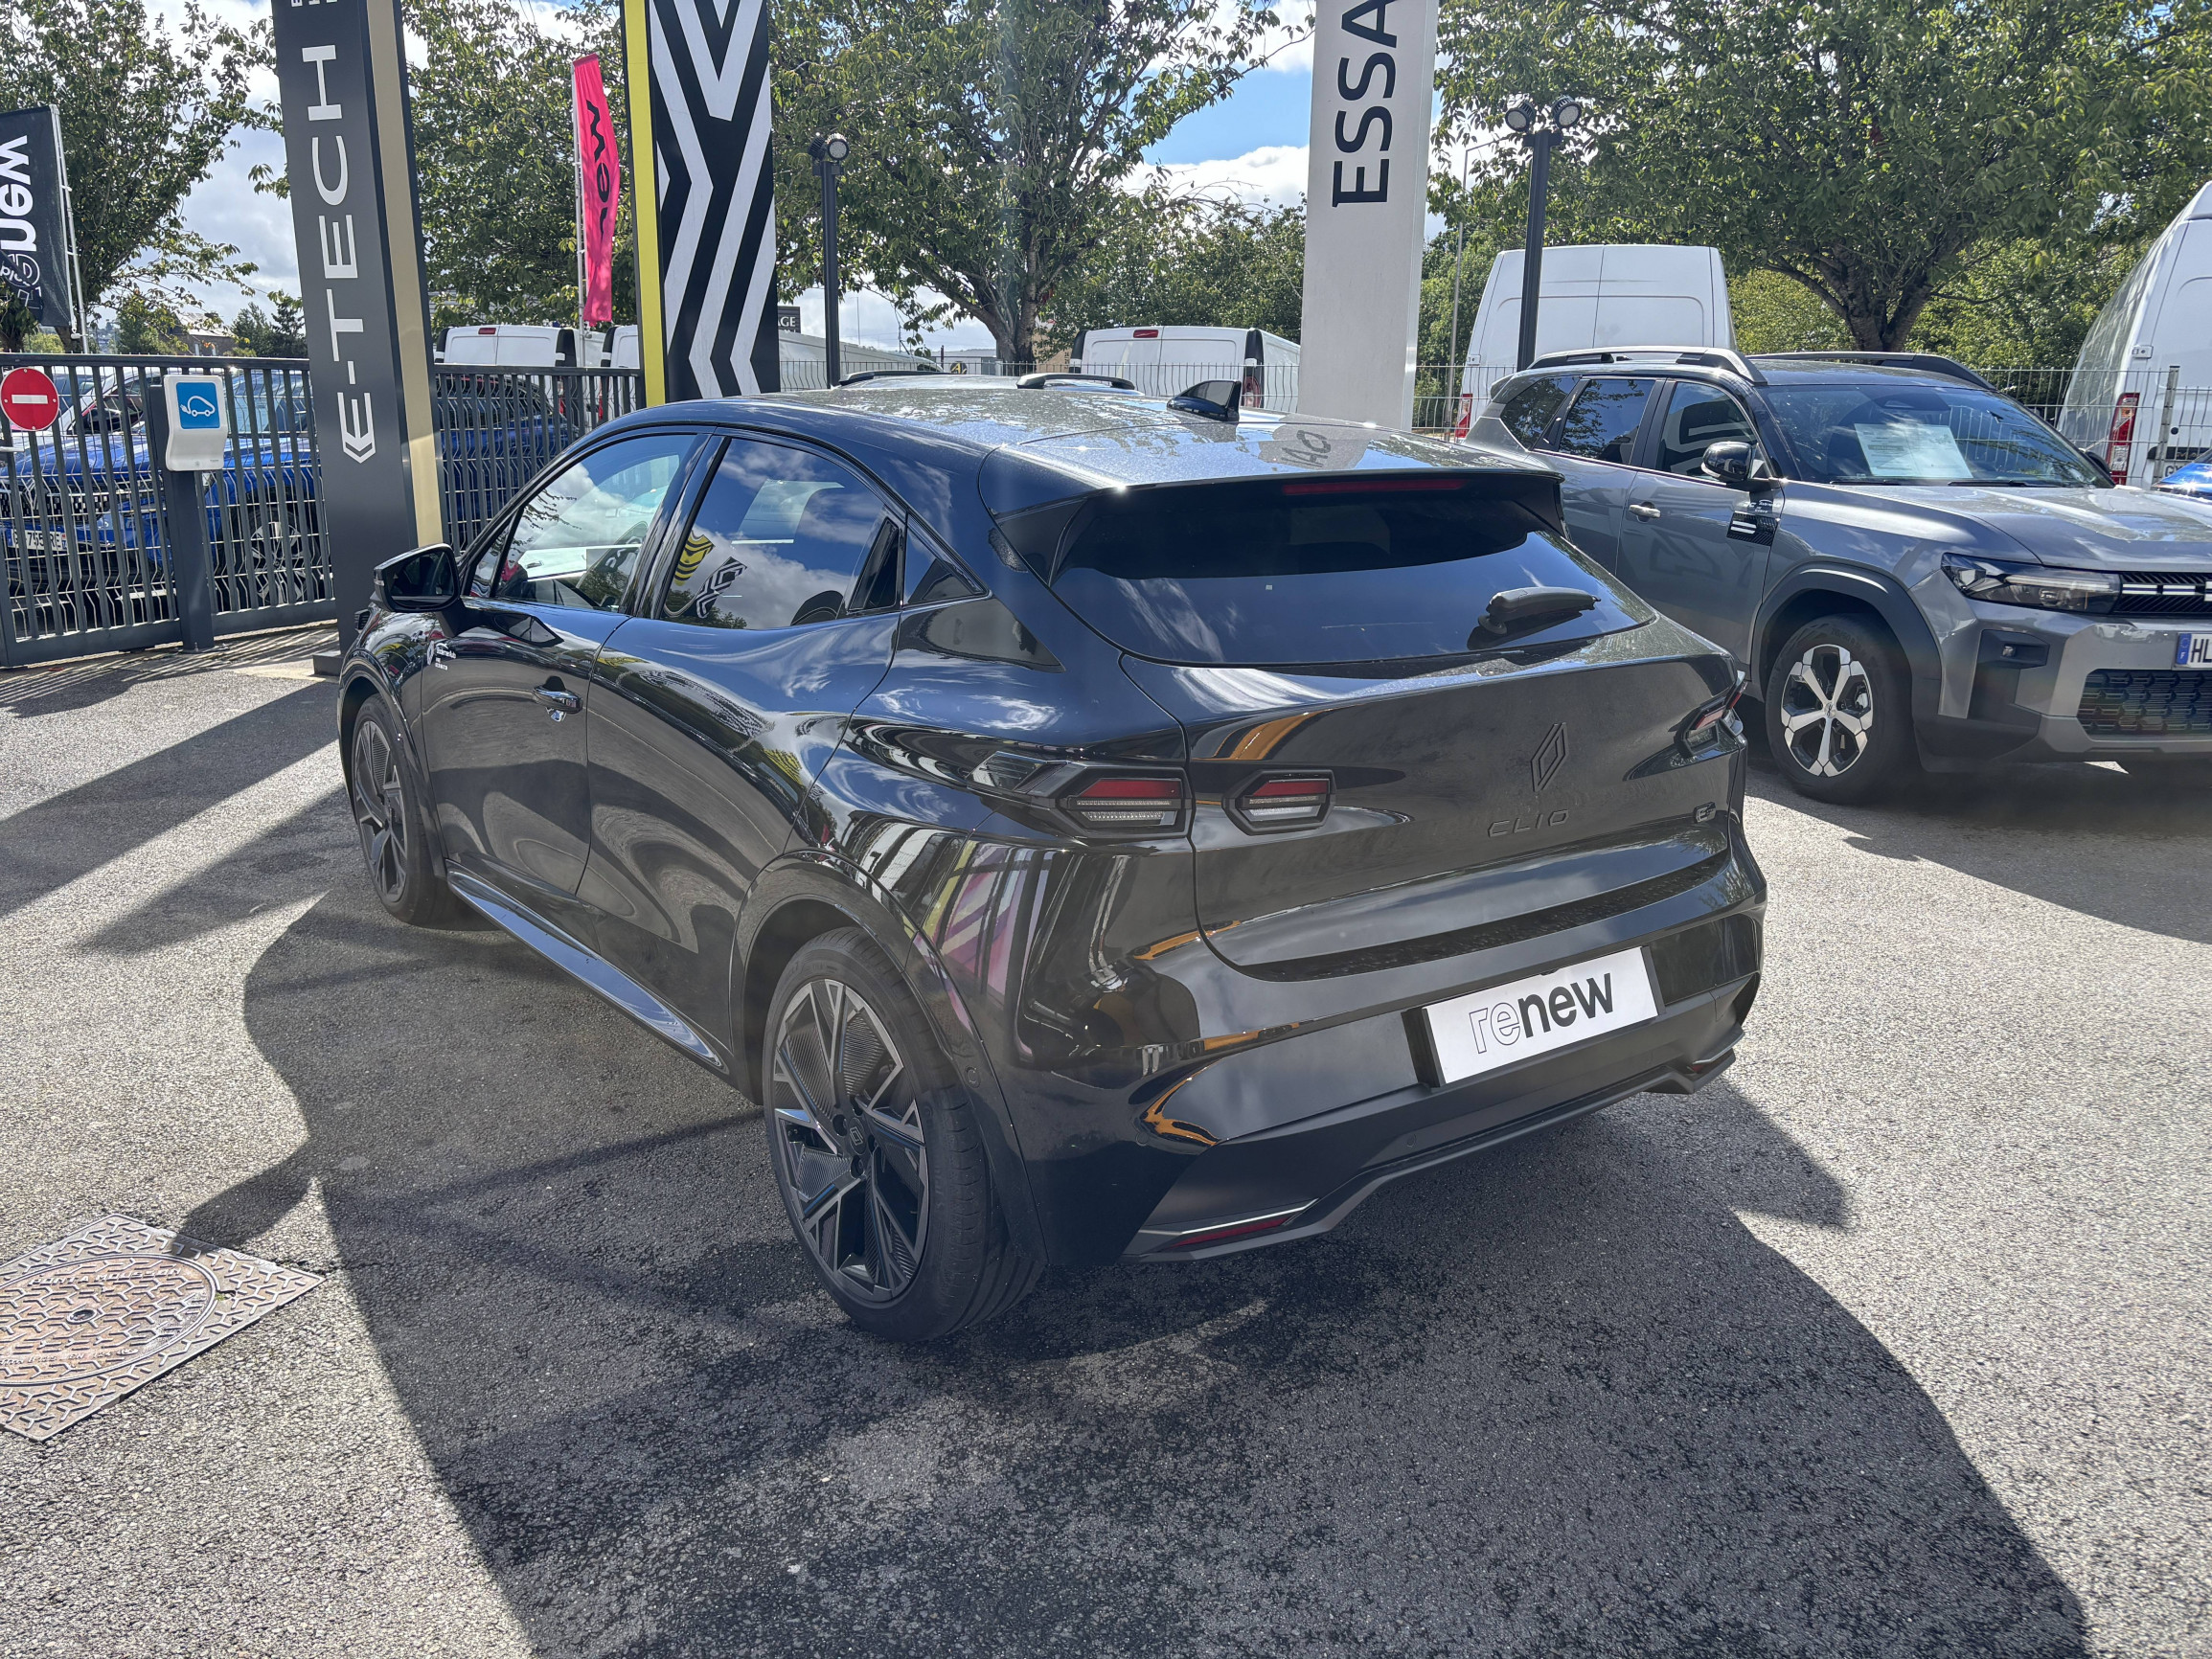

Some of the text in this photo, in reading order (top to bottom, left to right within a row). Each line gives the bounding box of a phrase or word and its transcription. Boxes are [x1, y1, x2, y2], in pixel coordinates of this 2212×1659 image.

[302, 44, 376, 464] E-TECH
[1488, 809, 1568, 838] CLIO
[1469, 972, 1613, 1055] renew
